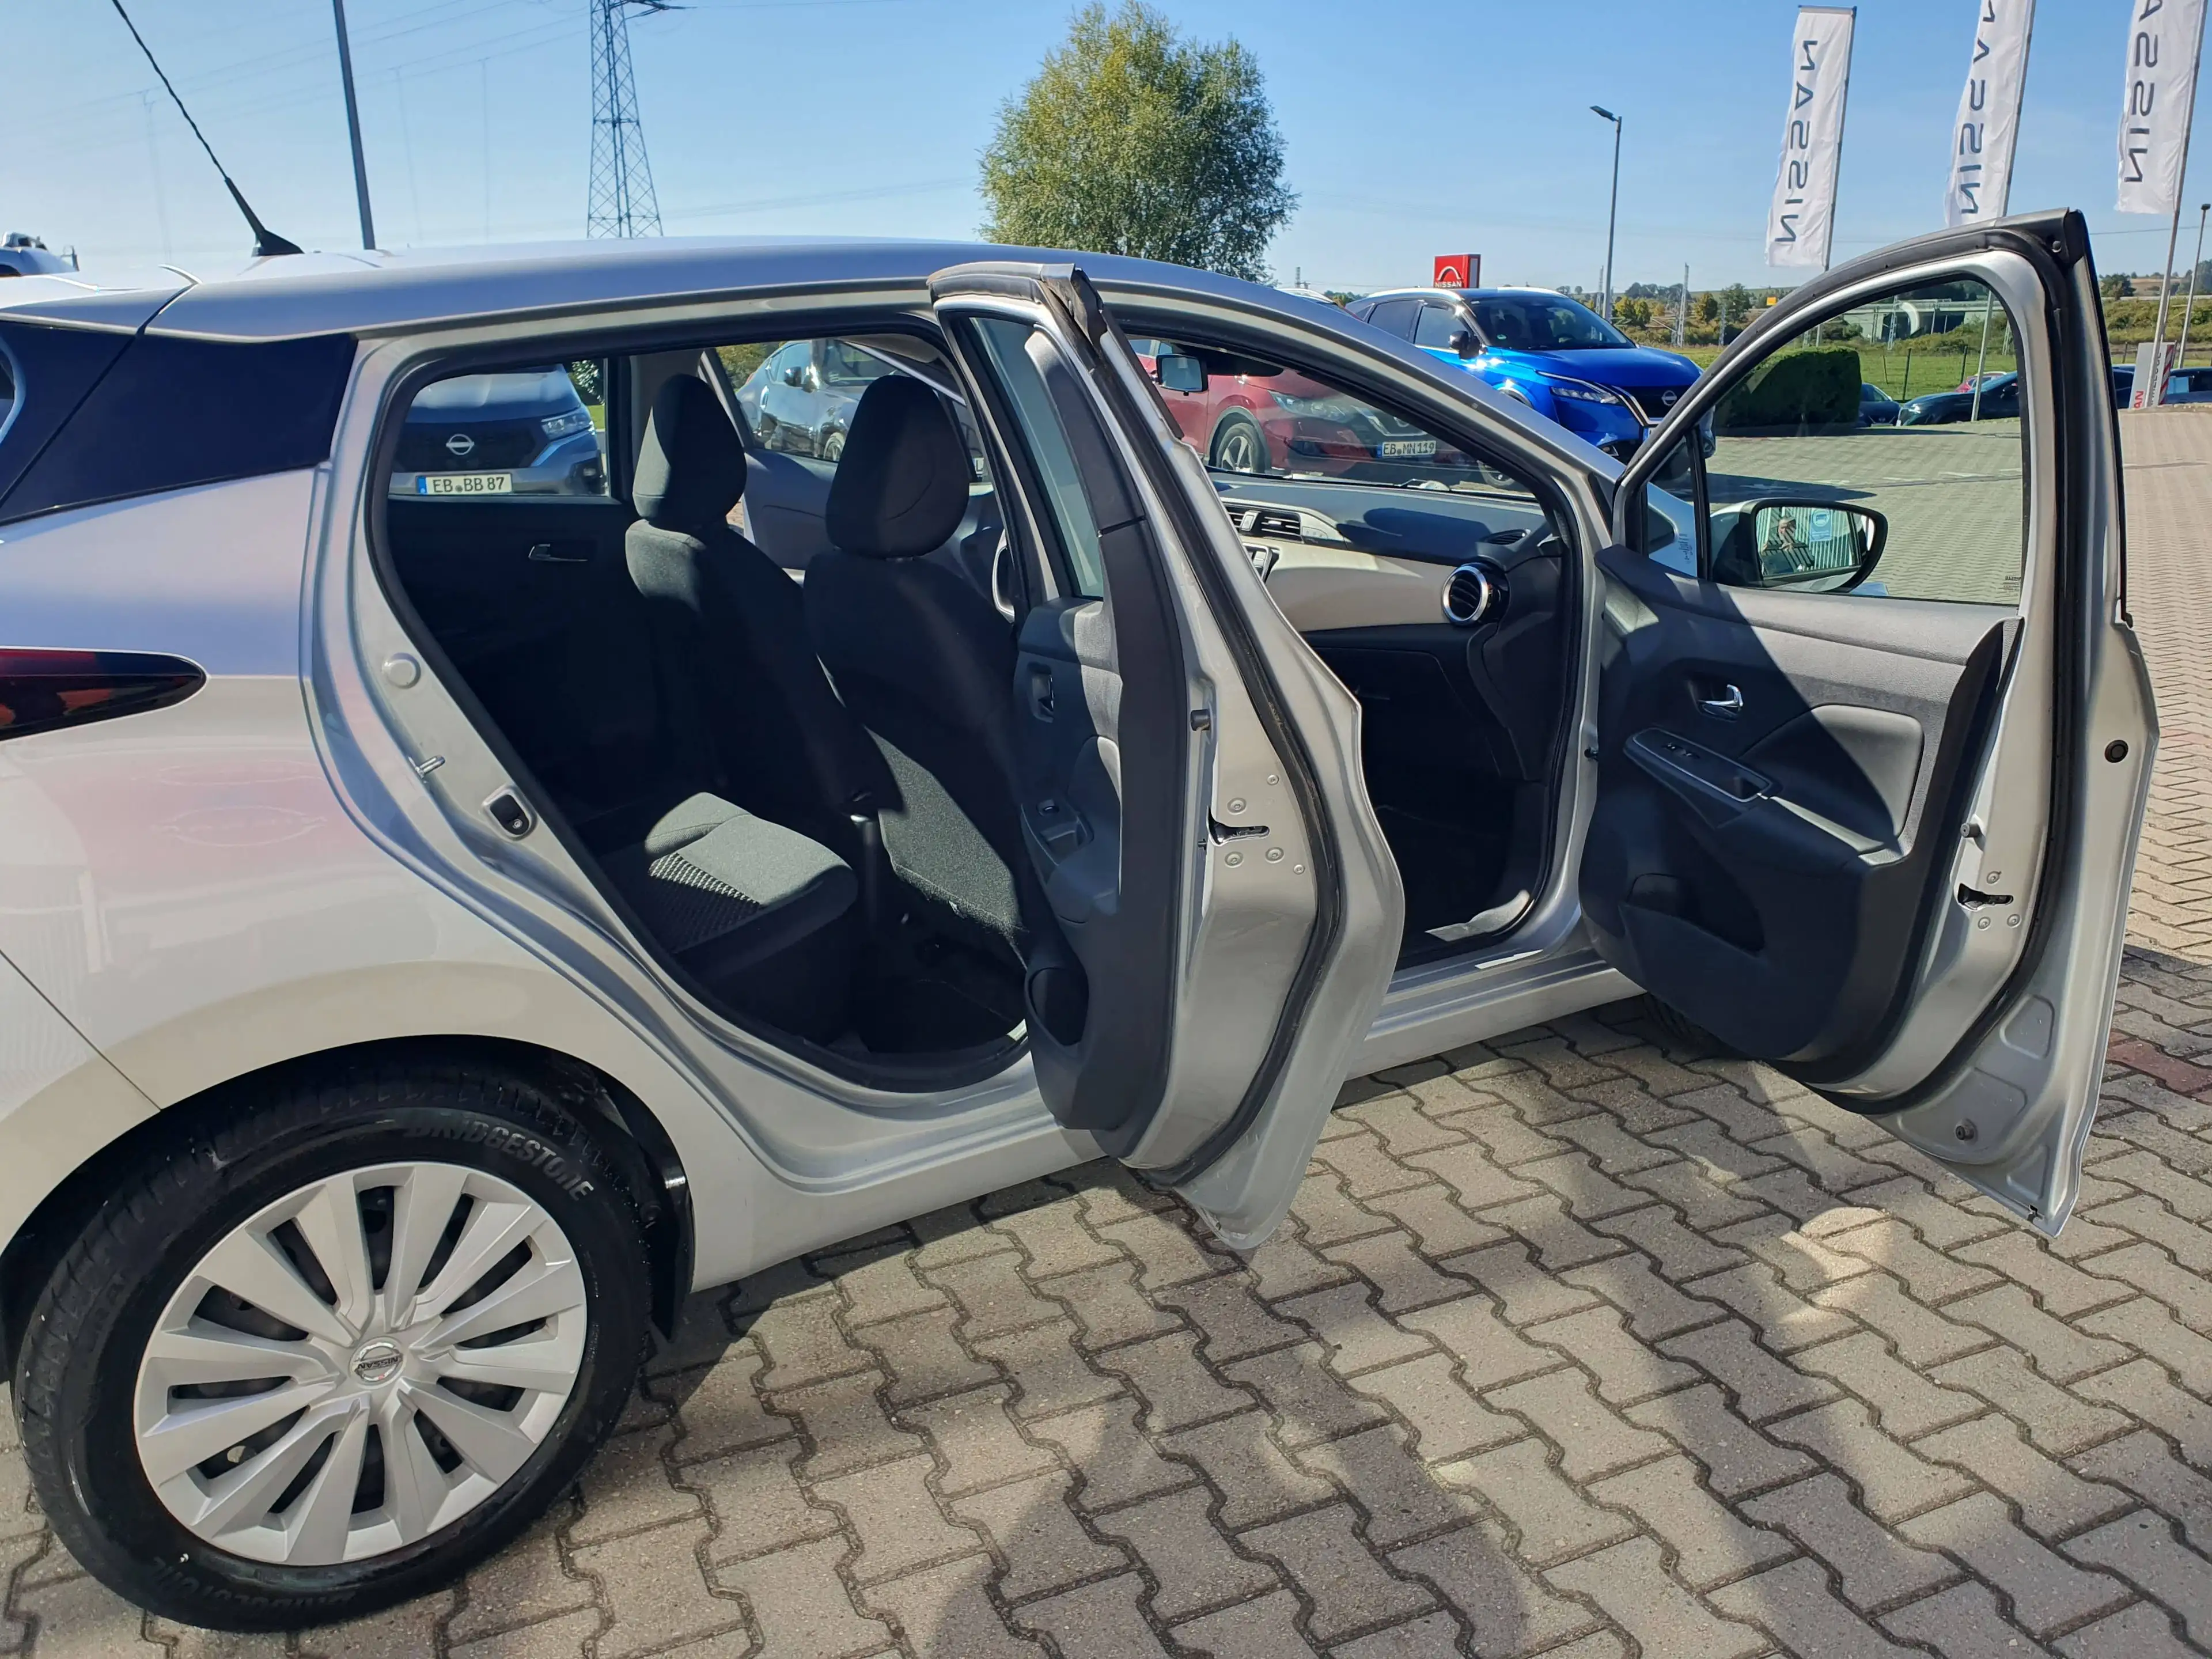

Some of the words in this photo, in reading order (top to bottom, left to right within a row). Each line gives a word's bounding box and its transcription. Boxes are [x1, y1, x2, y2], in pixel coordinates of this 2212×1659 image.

[1383, 443, 1396, 455] EB
[433, 479, 453, 493] EB
[463, 478, 484, 492] BB
[487, 476, 505, 490] 87
[358, 1356, 399, 1369] NISSAN
